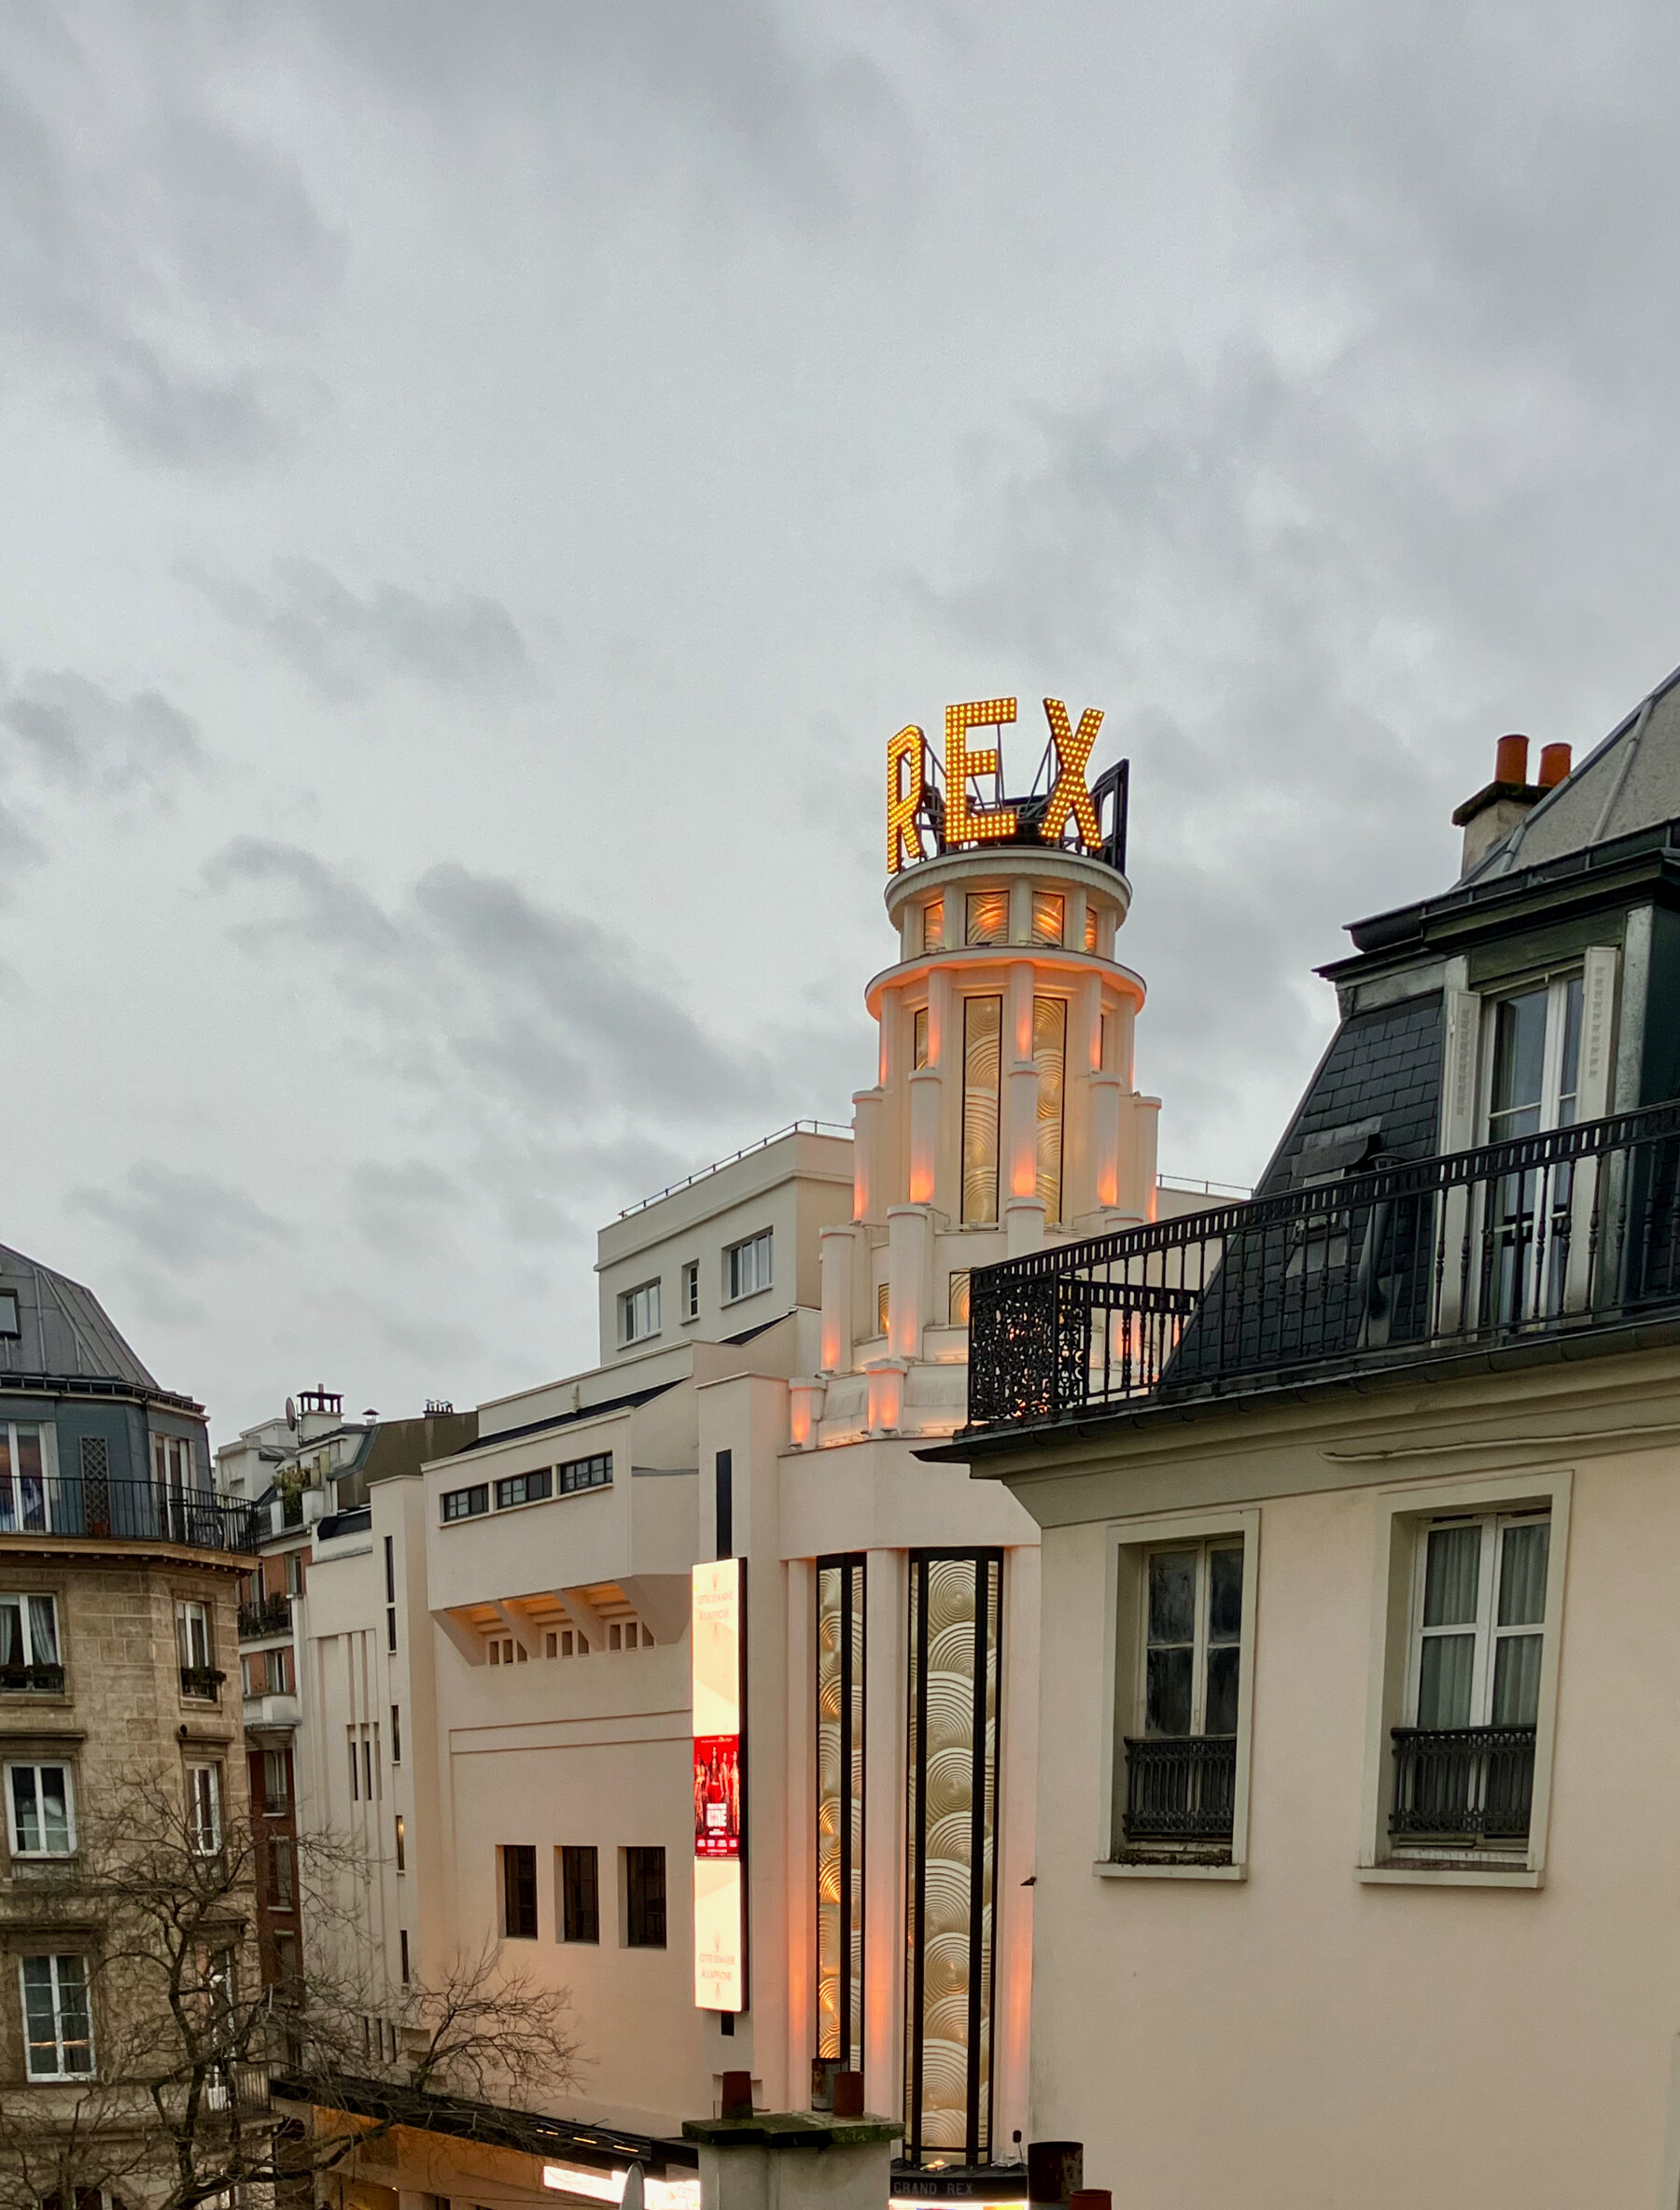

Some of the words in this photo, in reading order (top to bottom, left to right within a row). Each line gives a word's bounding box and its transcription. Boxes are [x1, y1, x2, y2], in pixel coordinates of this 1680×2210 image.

[887, 697, 1105, 874] REX
[893, 2181, 937, 2195] GRAND
[946, 2182, 973, 2195] REX
